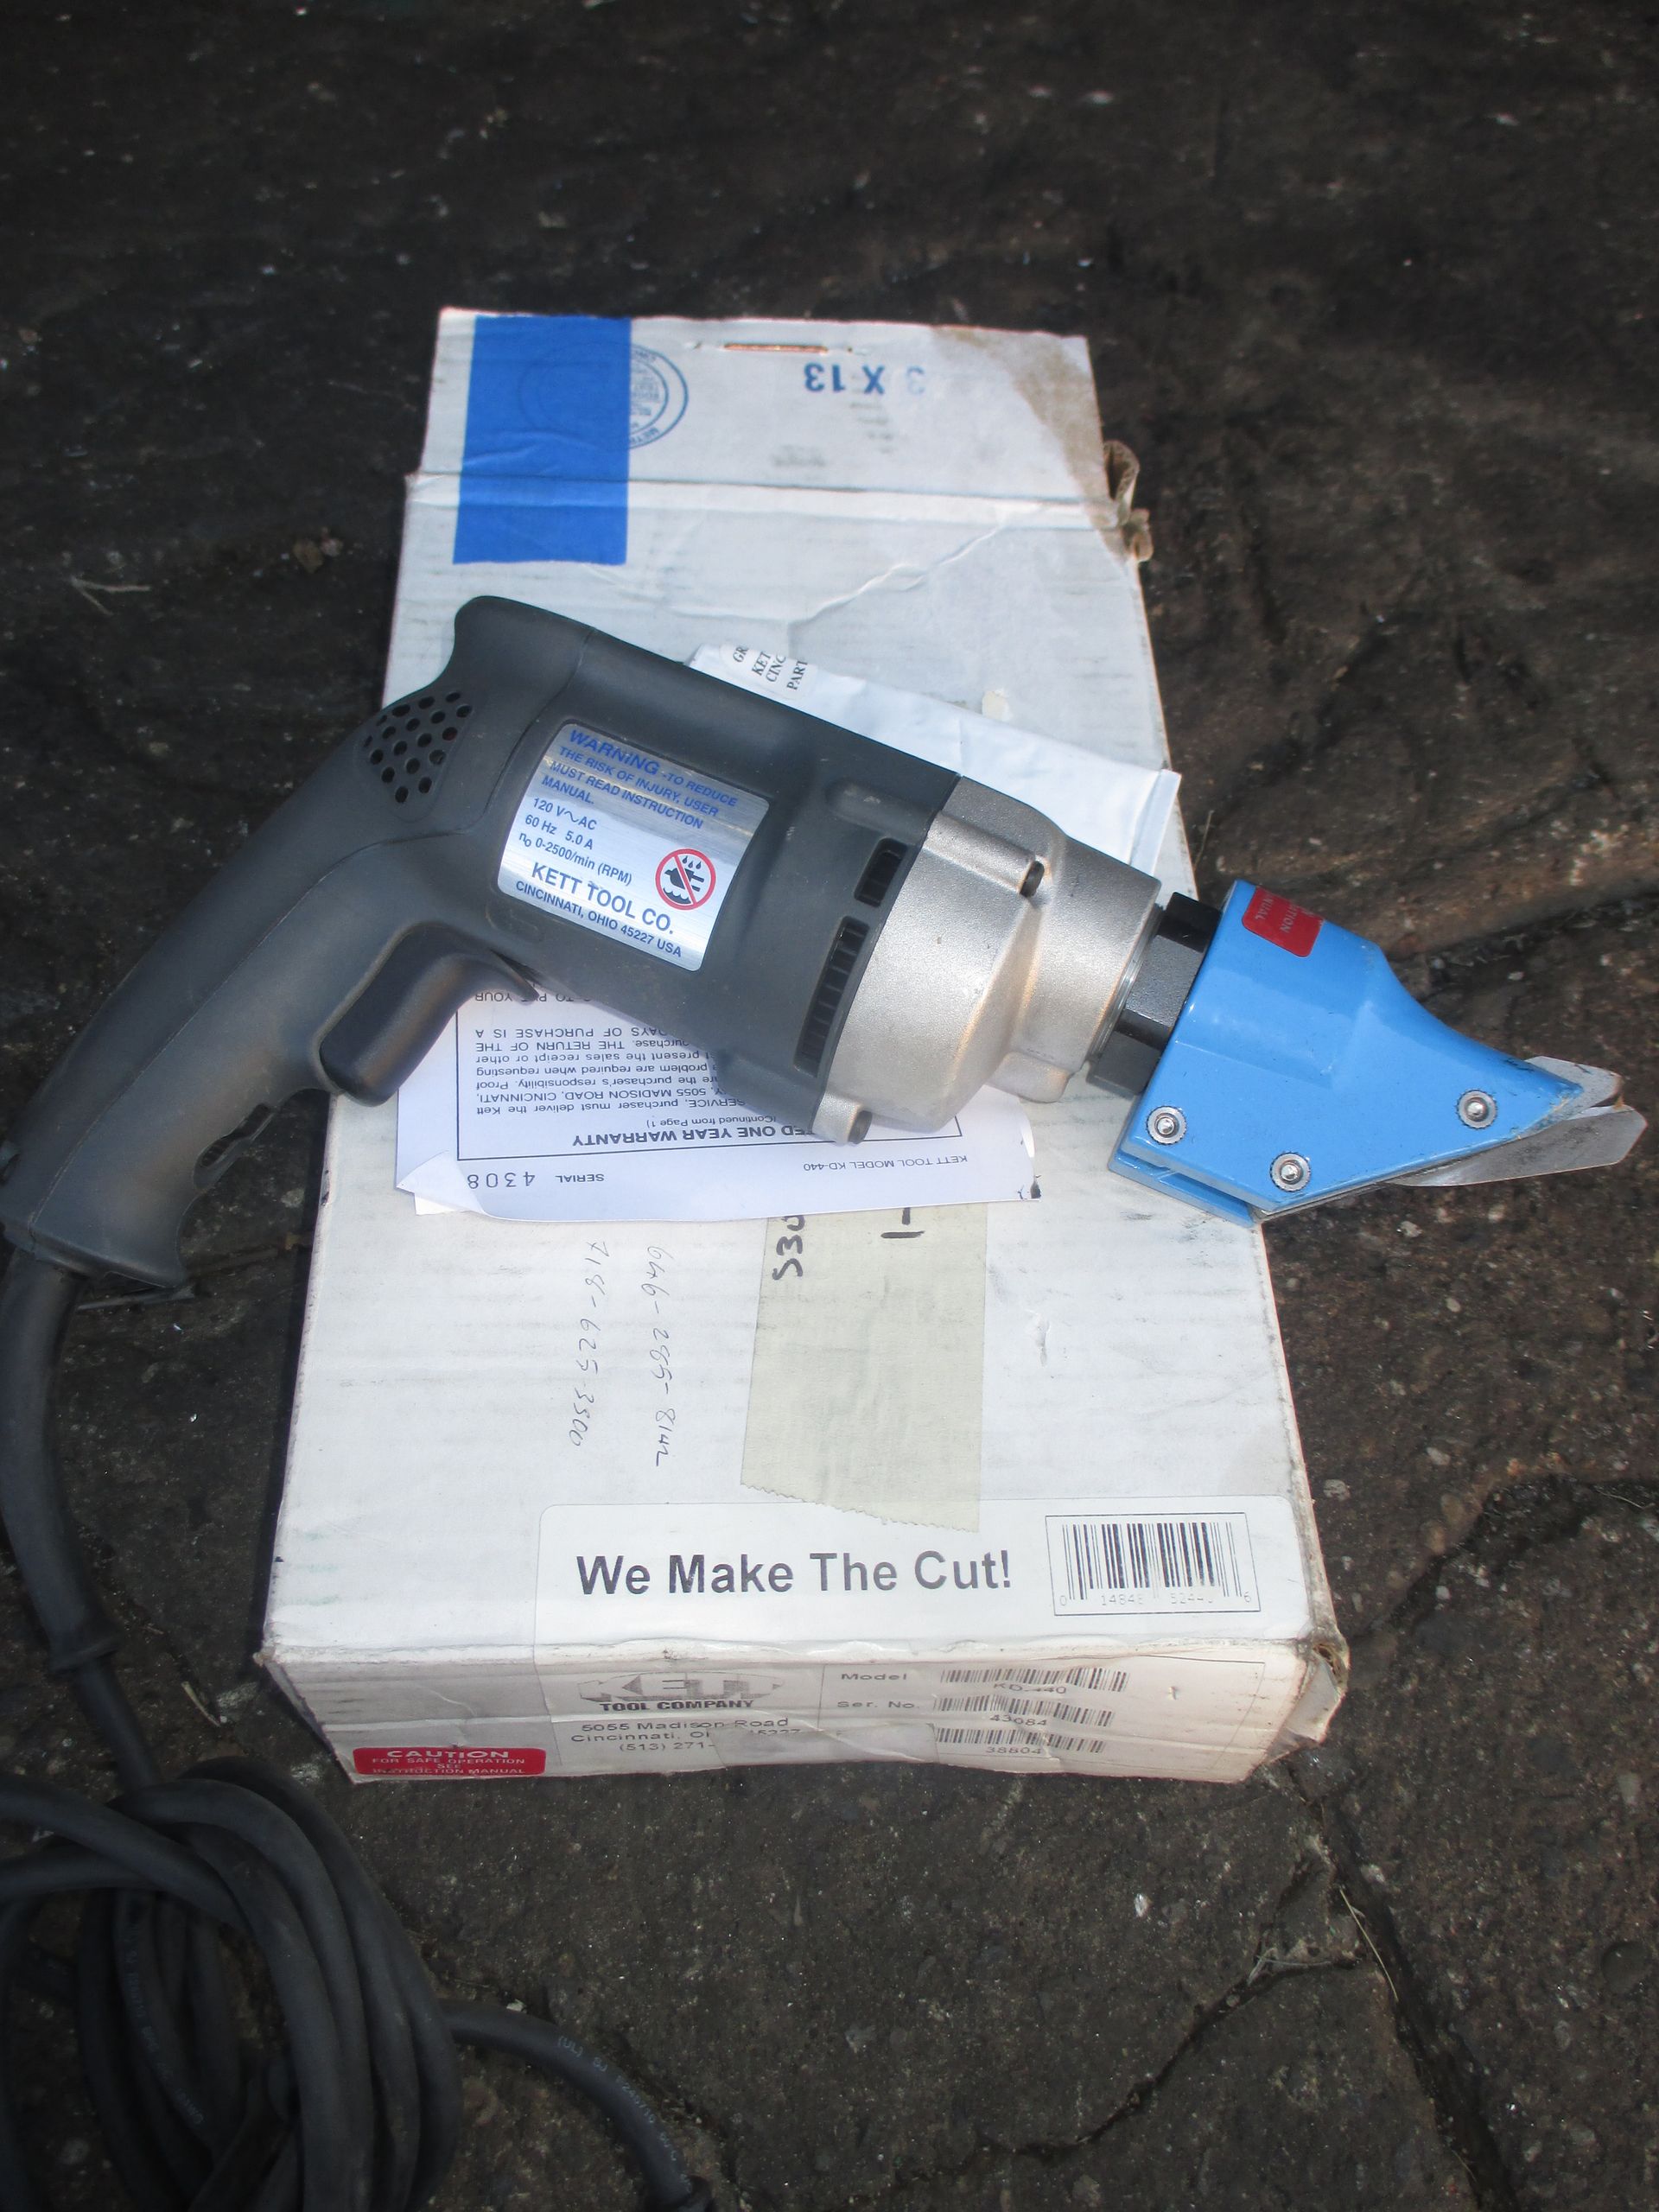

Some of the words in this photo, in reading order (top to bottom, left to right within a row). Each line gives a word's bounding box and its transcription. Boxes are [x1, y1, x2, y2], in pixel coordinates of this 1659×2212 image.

[804, 362, 845, 392] 13
[862, 364, 885, 395] X
[569, 729, 660, 776] WARNING
[686, 778, 738, 808] REDUCE
[559, 746, 582, 762] THE
[585, 753, 613, 774] RISK
[616, 769, 632, 783] OF
[635, 774, 680, 803] INJURY,
[683, 796, 719, 817] USER
[542, 774, 594, 804] MANUAL.
[550, 760, 583, 781] MUST
[585, 775, 620, 797] READ
[621, 787, 704, 830] INSTRUCTION
[532, 797, 554, 813] 120
[524, 814, 540, 827] 60
[542, 818, 557, 835] Hz
[565, 829, 583, 845] 5.0
[583, 837, 594, 851] A
[535, 837, 595, 868] 0-2500/min
[597, 862, 632, 887] (RPM)
[531, 861, 583, 895] KETT
[587, 880, 636, 918] TOOL
[641, 907, 674, 936] CO.
[516, 880, 585, 920] CINCINNATI,
[588, 910, 618, 931] OHIO
[620, 924, 654, 946] 45227
[657, 938, 682, 959] USA
[475, 993, 512, 1002] YOUR
[475, 1029, 484, 1038] A
[493, 1029, 506, 1038] IS
[517, 1028, 594, 1038] PURCHASE
[604, 1027, 621, 1037] OF
[476, 1043, 502, 1052] THE
[511, 1042, 529, 1052] OF
[537, 1041, 590, 1051] RETURN
[599, 1040, 624, 1050] THE
[536, 1053, 579, 1064] receipt
[626, 1052, 645, 1061] the
[652, 1050, 700, 1060] present
[476, 1056, 509, 1065] other
[476, 1066, 539, 1077] requesting
[582, 1065, 631, 1075] required
[660, 1063, 707, 1072] problem
[477, 1081, 508, 1090] Proof
[516, 1078, 595, 1090] responsibility.
[602, 1076, 671, 1088] purchaser's
[562, 1090, 604, 1101] ROAD,
[609, 1089, 671, 1099] MADISON
[677, 1088, 706, 1096] 5055
[477, 1092, 556, 1103] CINCINNATI,
[534, 1103, 575, 1114] deliver
[617, 1098, 678, 1110] purchaser
[477, 1106, 500, 1115] Kett
[647, 1120, 656, 1128] 1)
[660, 1119, 688, 1128] Page
[683, 1128, 732, 1140] YEAR
[738, 1127, 776, 1137] ONE
[573, 1130, 677, 1146] WARRANTY
[849, 1159, 894, 1169] MODEL
[897, 1157, 932, 1167] TOOL
[936, 1155, 968, 1165] KETT
[803, 1162, 845, 1172] KD-440
[467, 1171, 536, 1189] 4308
[555, 1173, 605, 1183] SERIAL
[577, 1554, 652, 1596] We
[668, 1554, 794, 1594] Make
[810, 1552, 898, 1592] The
[913, 1549, 1012, 1591] Cut!
[841, 1672, 907, 1681] Model
[600, 1701, 651, 1712] TOOL
[657, 1699, 754, 1711] COMPANY
[837, 1699, 879, 1709] Ser.
[888, 1700, 920, 1710] No.
[582, 1723, 630, 1732] 5055
[637, 1719, 724, 1731] Madison
[734, 1717, 789, 1728] Road
[620, 1742, 666, 1751] (513)
[387, 1750, 509, 1759] CAUTION
